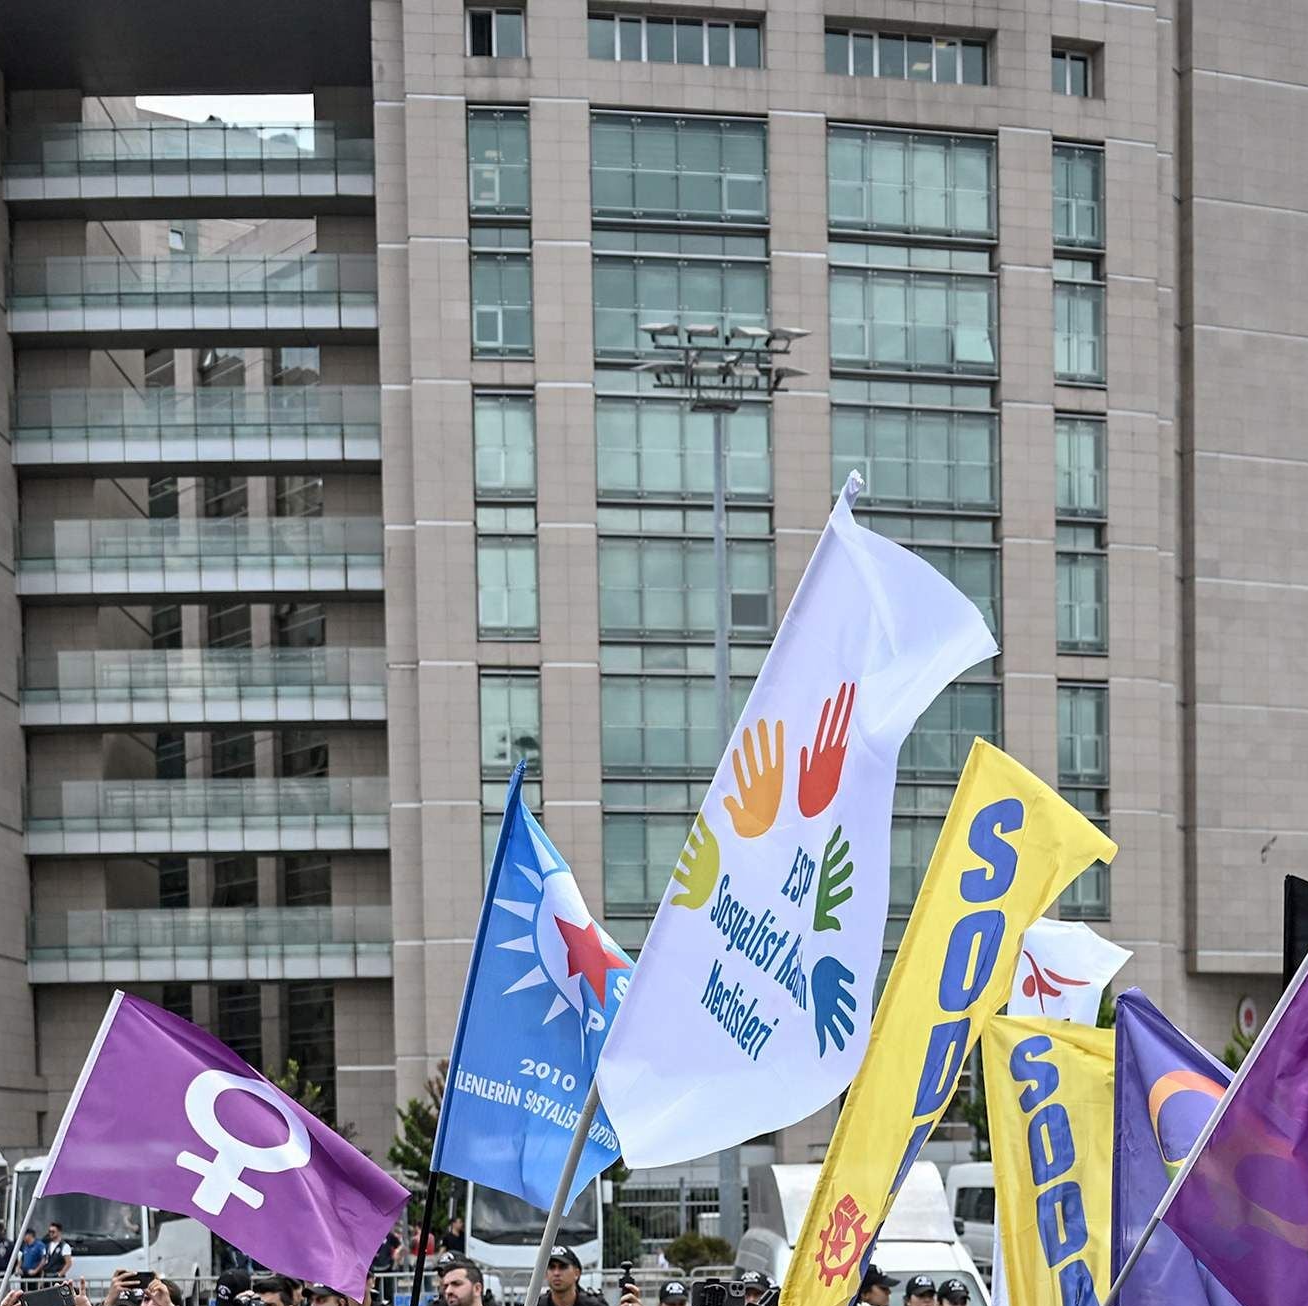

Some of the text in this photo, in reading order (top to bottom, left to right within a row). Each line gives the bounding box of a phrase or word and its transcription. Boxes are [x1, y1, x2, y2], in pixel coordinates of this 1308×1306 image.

[781, 846, 816, 908] ESP
[710, 873, 790, 973] Sosyalist
[700, 958, 780, 1062] Meclisleri
[454, 1064, 522, 1106] İLENLERİN
[587, 1117, 619, 1152] ARTİSİ
[519, 1058, 576, 1092] 2010
